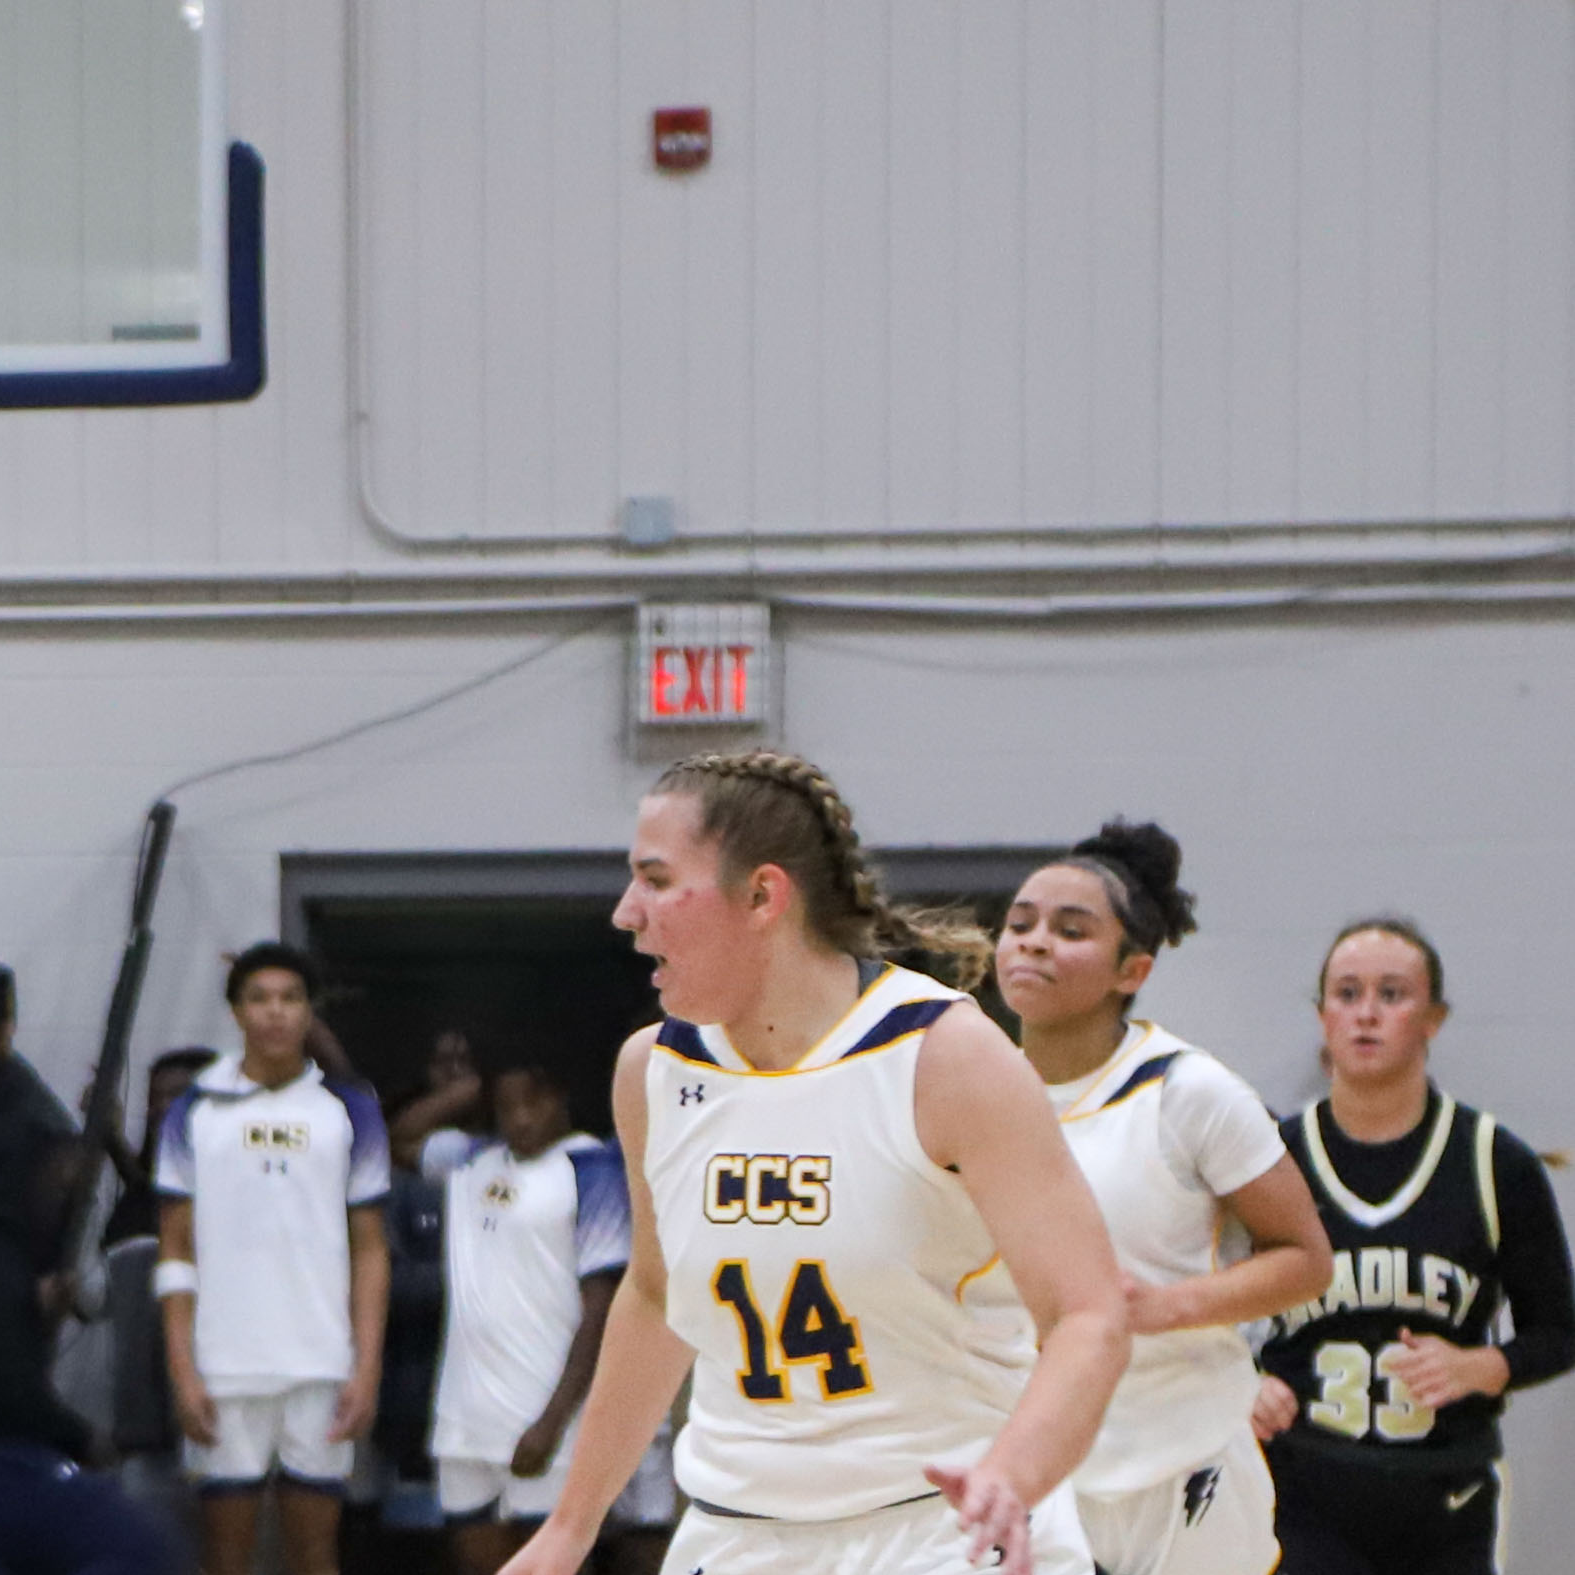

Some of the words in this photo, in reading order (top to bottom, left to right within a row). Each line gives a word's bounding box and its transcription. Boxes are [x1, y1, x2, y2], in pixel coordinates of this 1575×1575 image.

[653, 645, 754, 715] EXIT
[703, 1153, 832, 1225] CCS
[709, 1258, 875, 1404] 14
[1275, 1245, 1480, 1335] ADLEY
[1307, 1341, 1437, 1441] 33
